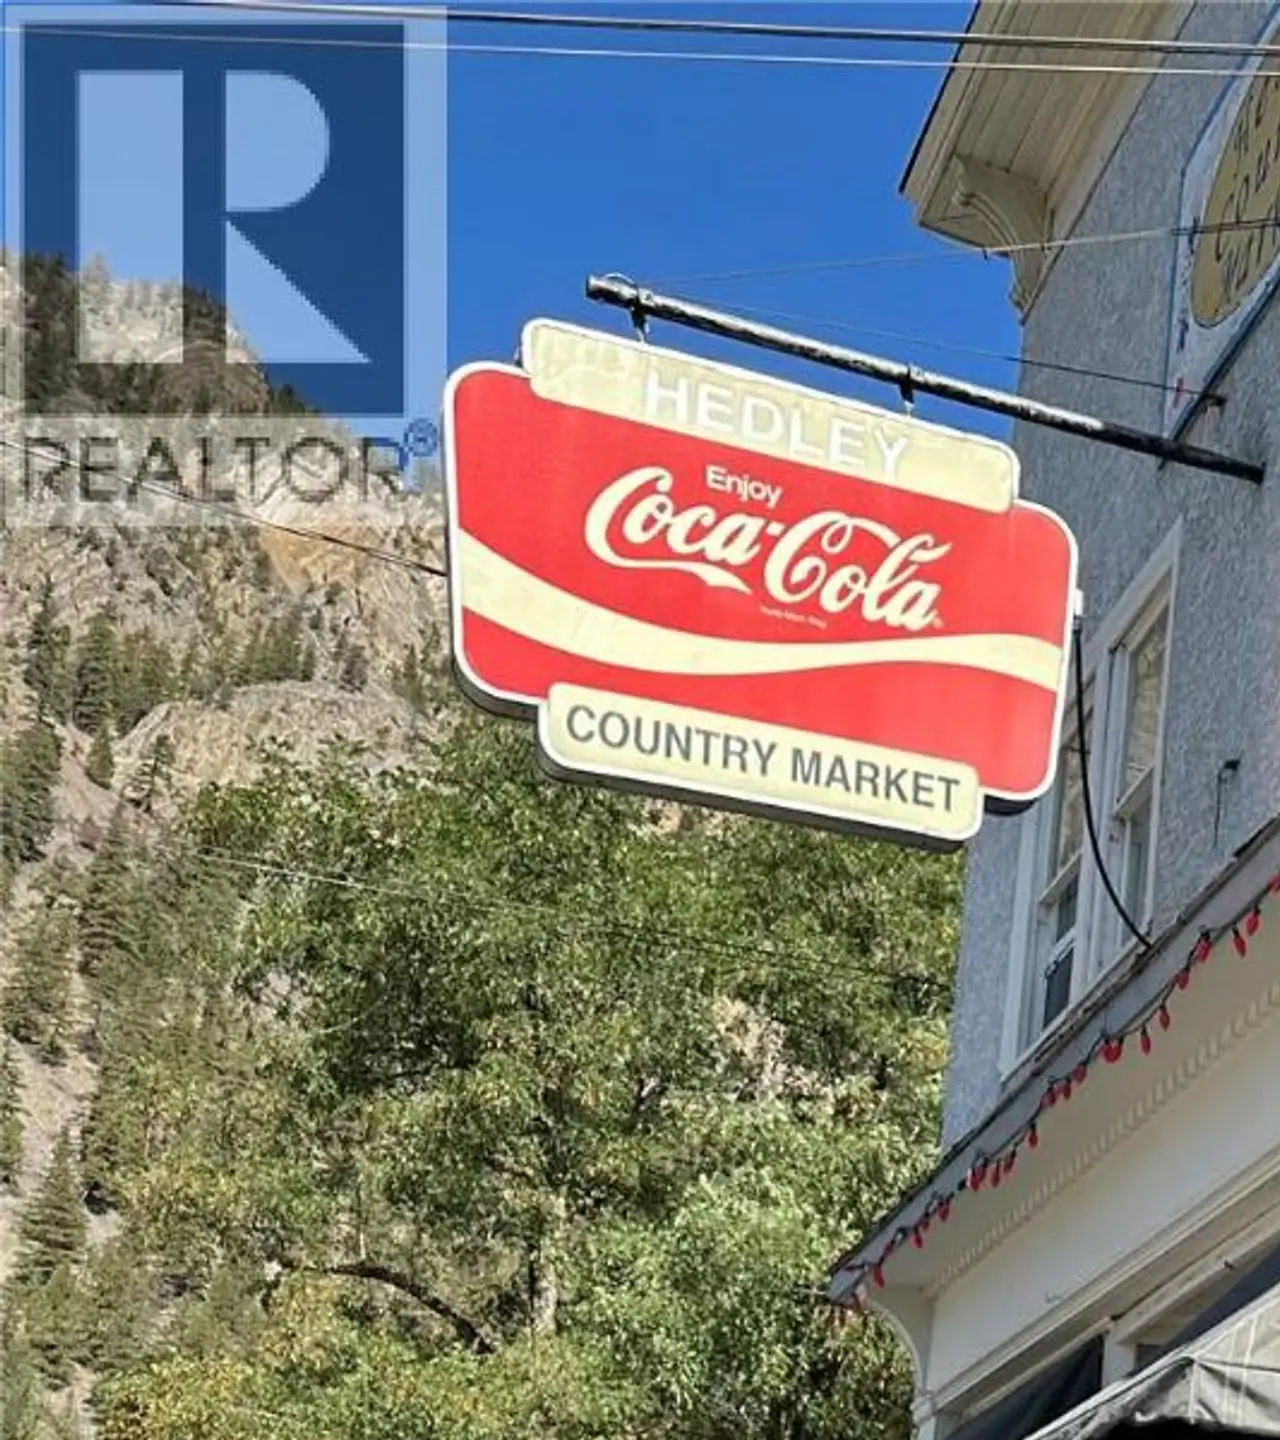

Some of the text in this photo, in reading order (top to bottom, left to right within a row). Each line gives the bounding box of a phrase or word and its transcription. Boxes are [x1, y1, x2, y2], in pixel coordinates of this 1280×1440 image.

[645, 371, 908, 473] HEDLEY
[706, 465, 783, 508] Enjoy
[584, 466, 952, 630] Coca-Cola
[566, 704, 960, 812] COUNTRY MARKET
